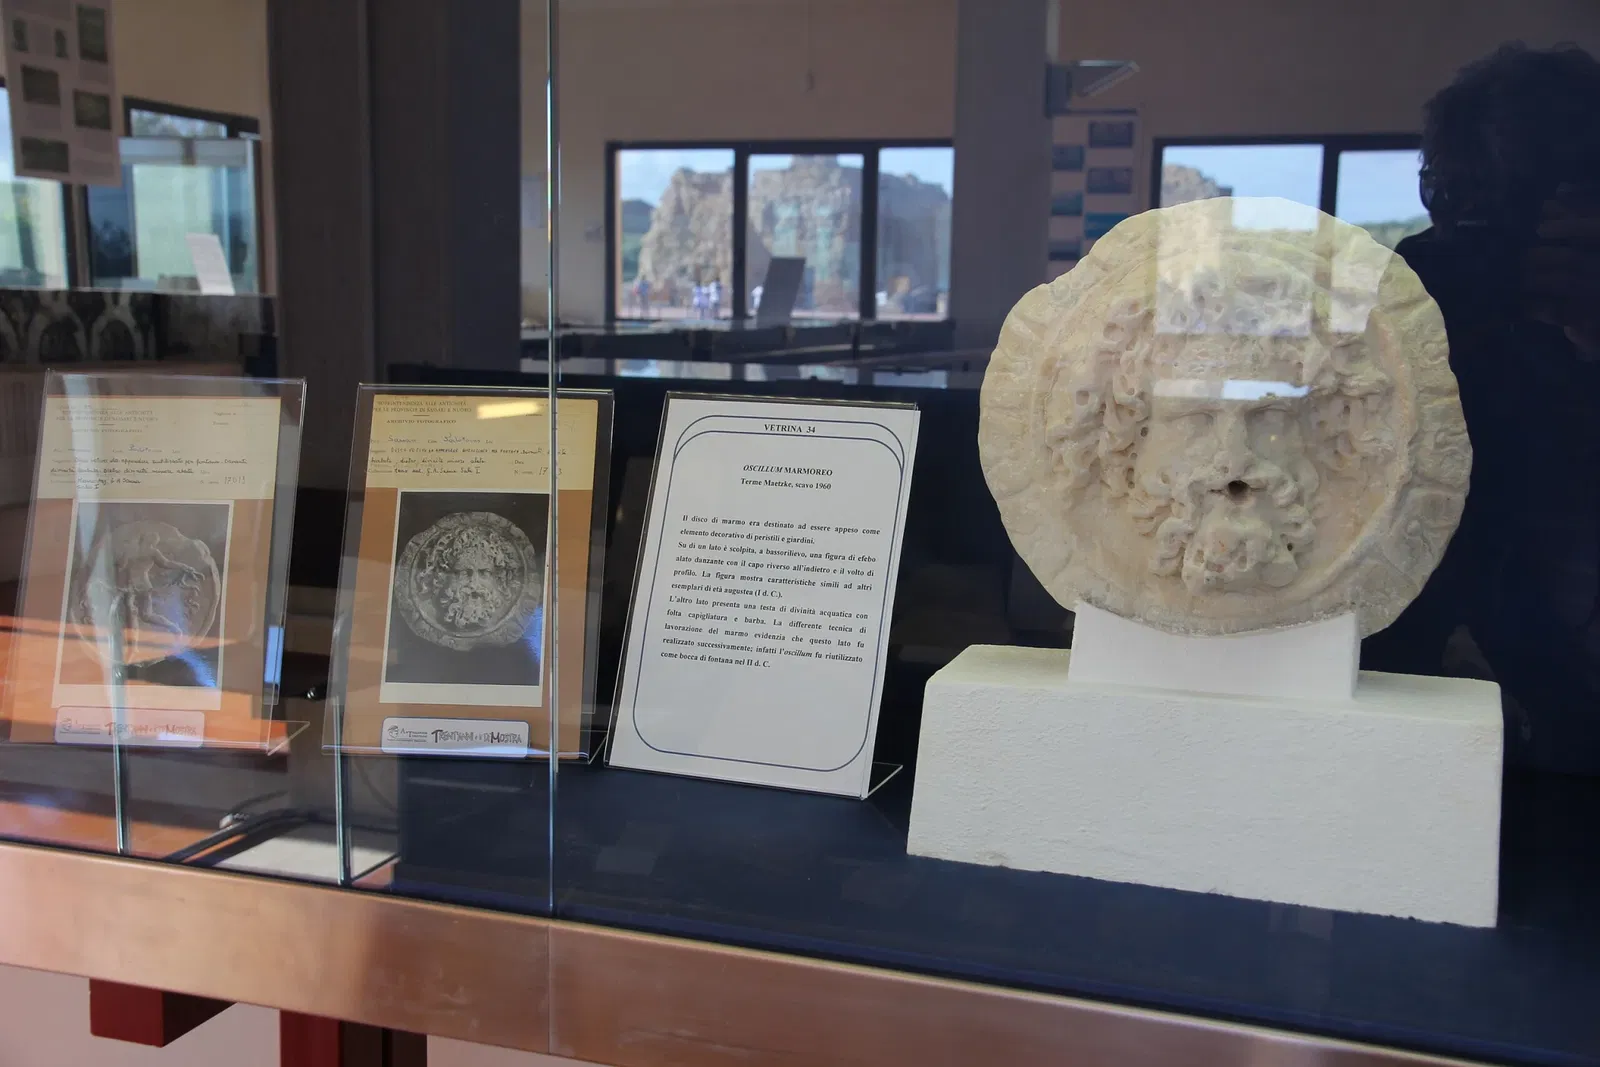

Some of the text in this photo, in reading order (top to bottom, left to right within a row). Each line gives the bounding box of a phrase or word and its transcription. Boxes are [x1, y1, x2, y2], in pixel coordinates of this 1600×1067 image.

[764, 423, 816, 436] VETRINA 34
[743, 464, 833, 477] OSCILLUM MARMOREO
[741, 476, 832, 490] Terme Maetzke, scavo 1960
[691, 515, 708, 523] disco
[711, 516, 718, 524] di
[721, 519, 746, 528] marmo
[764, 520, 794, 529] destinato
[798, 523, 807, 532] ad
[680, 528, 709, 536] elemento
[710, 530, 745, 539] decorativo
[745, 532, 753, 540] di
[754, 533, 780, 544] peristili
[786, 535, 815, 546] giardini.
[708, 543, 722, 551] lato
[729, 545, 757, 556] scolpita,
[759, 548, 764, 556] a
[766, 548, 807, 560] bassorilievo,
[825, 552, 846, 561] figura
[848, 554, 856, 563] di
[857, 554, 876, 563] efebo
[676, 555, 692, 563] alato
[694, 556, 724, 565] danzante
[741, 559, 746, 567] il
[748, 559, 764, 570] capo
[766, 560, 791, 572] riverso
[840, 567, 845, 575] il
[847, 568, 865, 577] volto
[867, 569, 874, 577] di
[673, 569, 872, 591] profilo. La figura mostra caratteristiche simili ad altri
[671, 583, 703, 592] esemplari
[712, 585, 723, 593] età
[724, 588, 753, 596] augustea
[696, 596, 709, 605] lato
[712, 600, 740, 608] presenta
[760, 604, 776, 613] testa
[790, 606, 816, 616] divinità
[819, 610, 853, 619] acquatica
[667, 608, 682, 617] folta
[688, 612, 728, 621] capigliatura
[744, 615, 766, 625] barba.
[773, 618, 782, 626] La
[789, 620, 822, 631] differente
[829, 624, 853, 633] tecnica
[859, 626, 867, 634] di
[664, 623, 703, 633] lavorazione
[708, 627, 719, 635] del
[724, 628, 749, 637] marmo
[754, 631, 786, 641] evidenzia
[791, 634, 804, 642] che
[837, 639, 852, 647] lato
[857, 640, 865, 648] fu
[662, 636, 695, 648] realizzato
[697, 642, 753, 653] successivamente;
[756, 645, 777, 655] infatti
[815, 650, 823, 659] fu
[825, 652, 863, 663] riutilizzato
[679, 652, 698, 661] bocca
[708, 655, 733, 664] fontana
[734, 656, 745, 665] nel
[746, 657, 753, 666] II
[490, 731, 522, 744] MOSTRA
